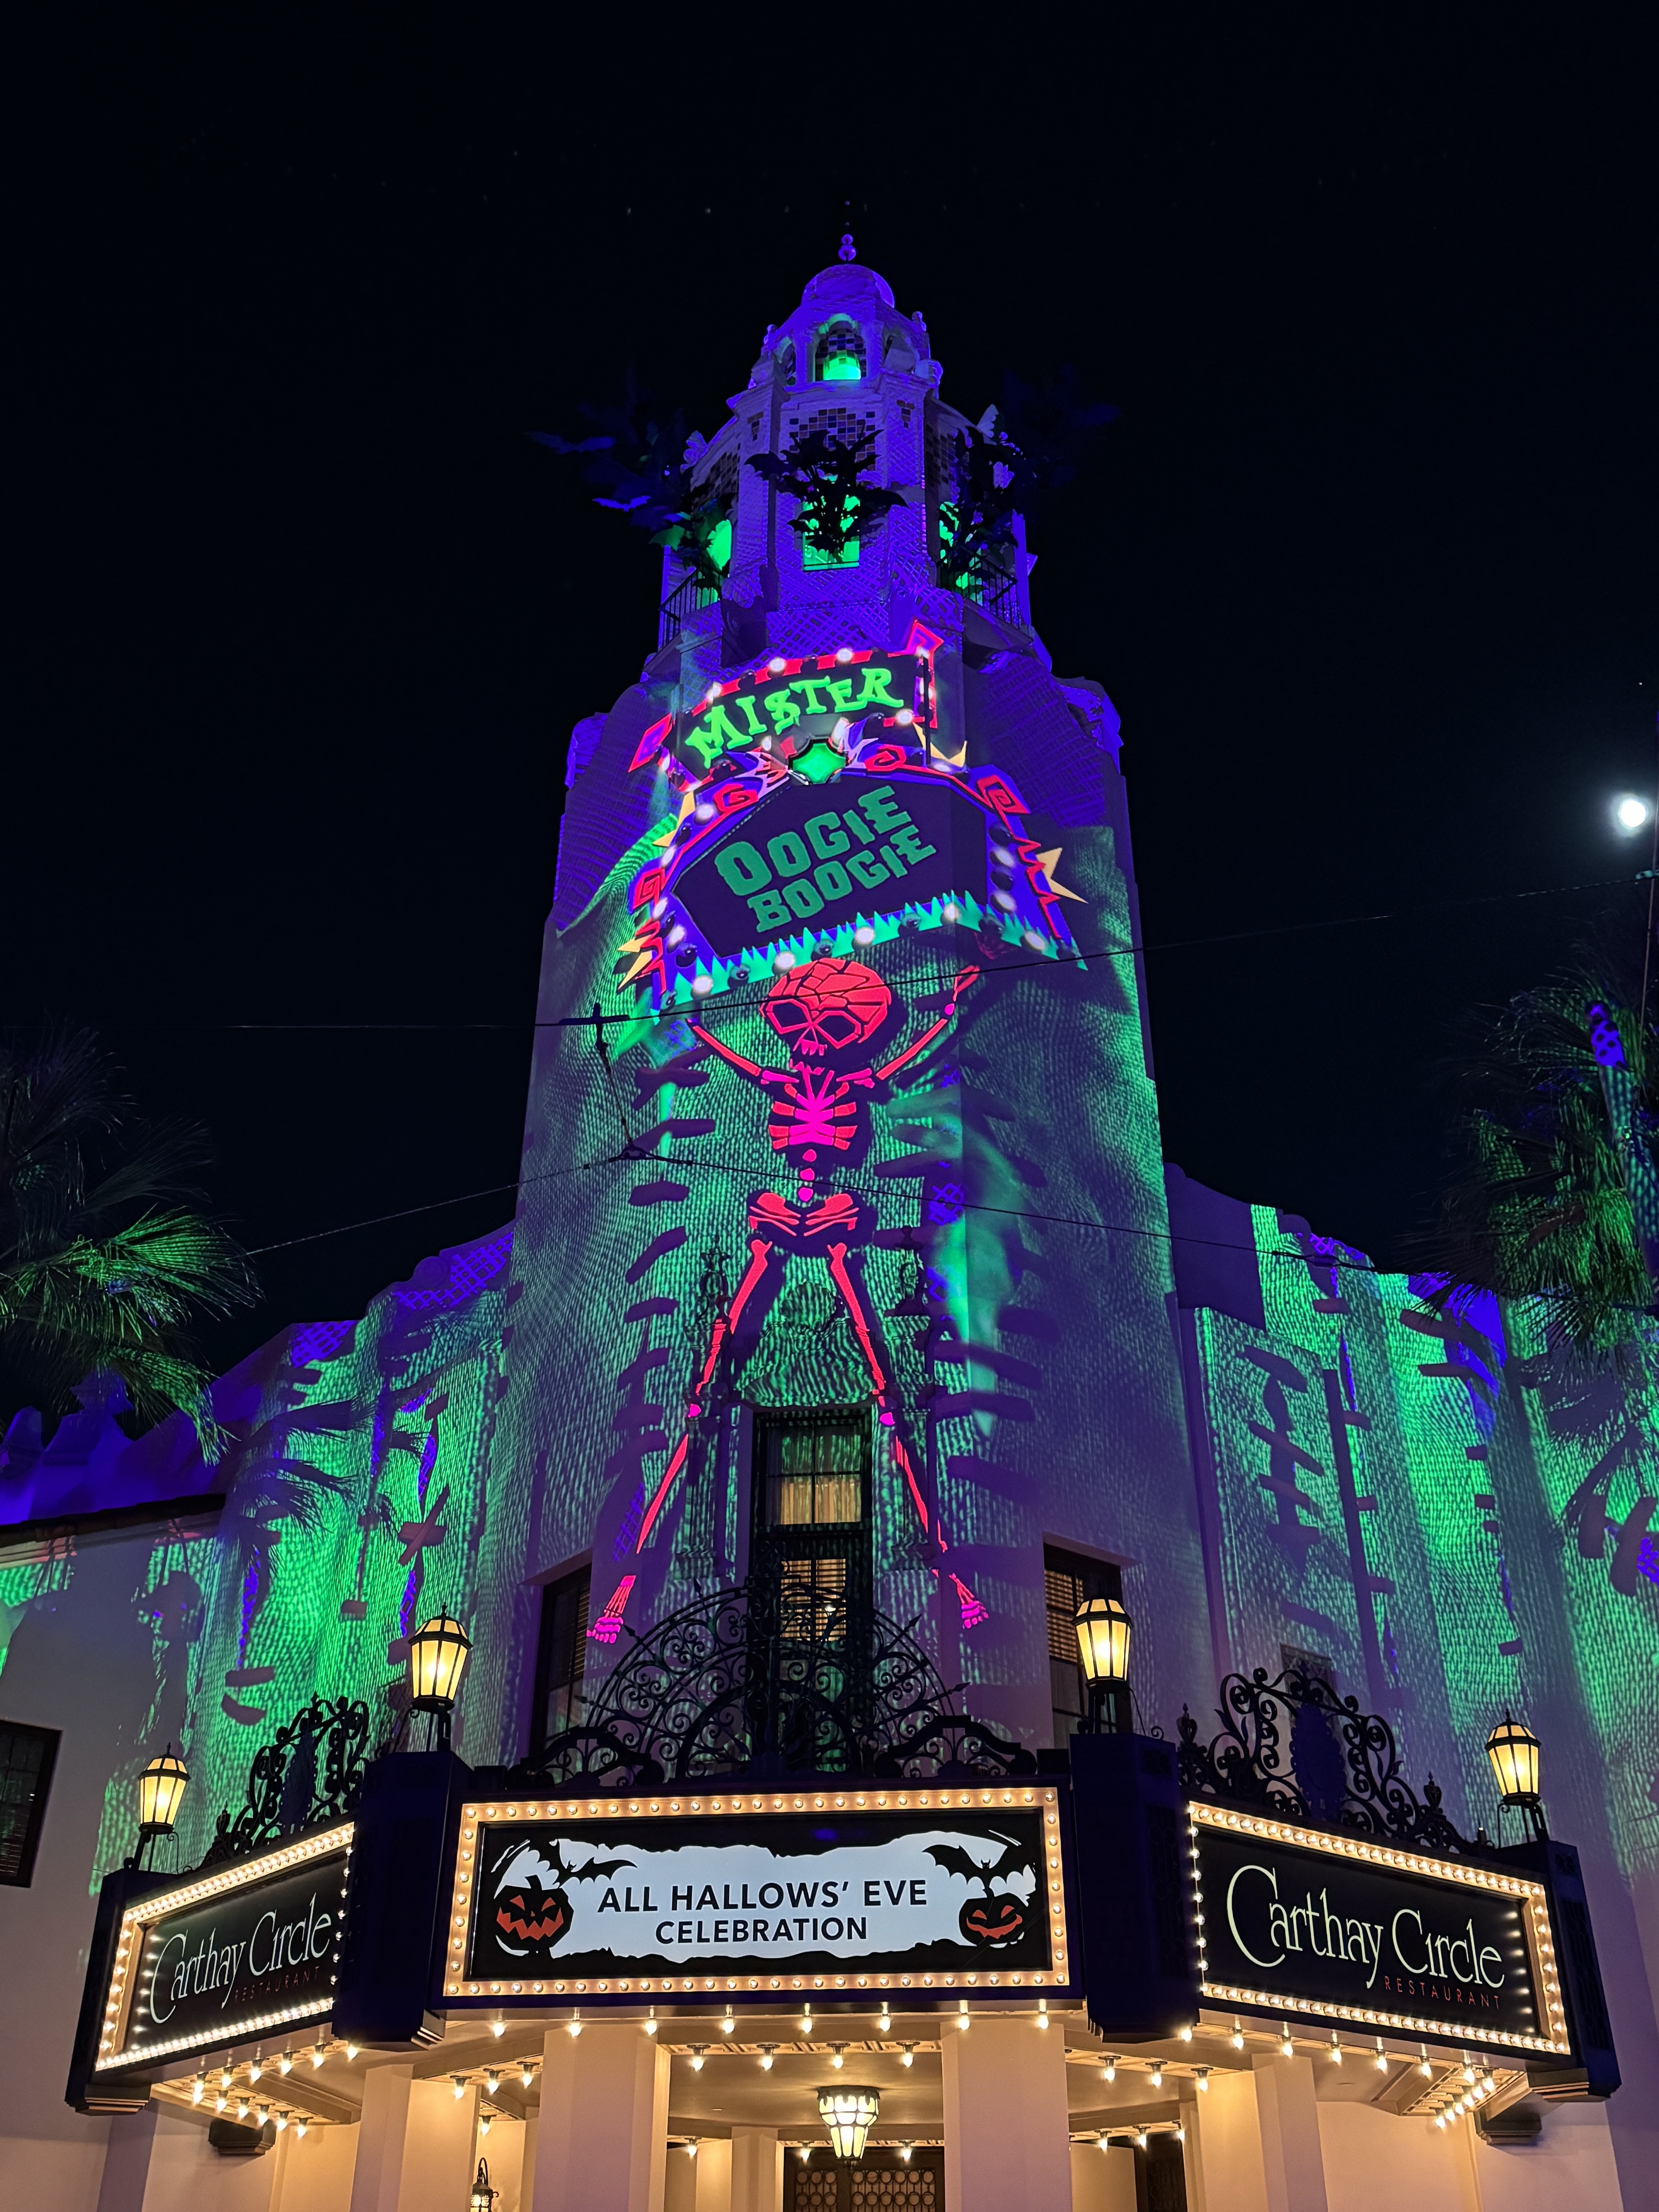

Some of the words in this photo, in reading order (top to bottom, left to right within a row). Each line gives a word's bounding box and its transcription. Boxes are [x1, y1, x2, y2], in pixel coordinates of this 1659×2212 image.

[686, 667, 904, 768] MISTER
[715, 785, 910, 896] OOGIE
[747, 825, 937, 932] BOOGIE
[597, 1887, 658, 1913] ALL
[864, 1879, 927, 1906] EVE
[655, 1917, 868, 1944] CELEBRATION
[1227, 1865, 1383, 1989] Carthay
[1392, 1909, 1505, 1988] Circle
[150, 1928, 246, 2024] Carthay
[249, 1892, 331, 1976] Circle
[234, 1966, 320, 2002] RESTAURANT
[1385, 1975, 1500, 2010] RESTAURANT
